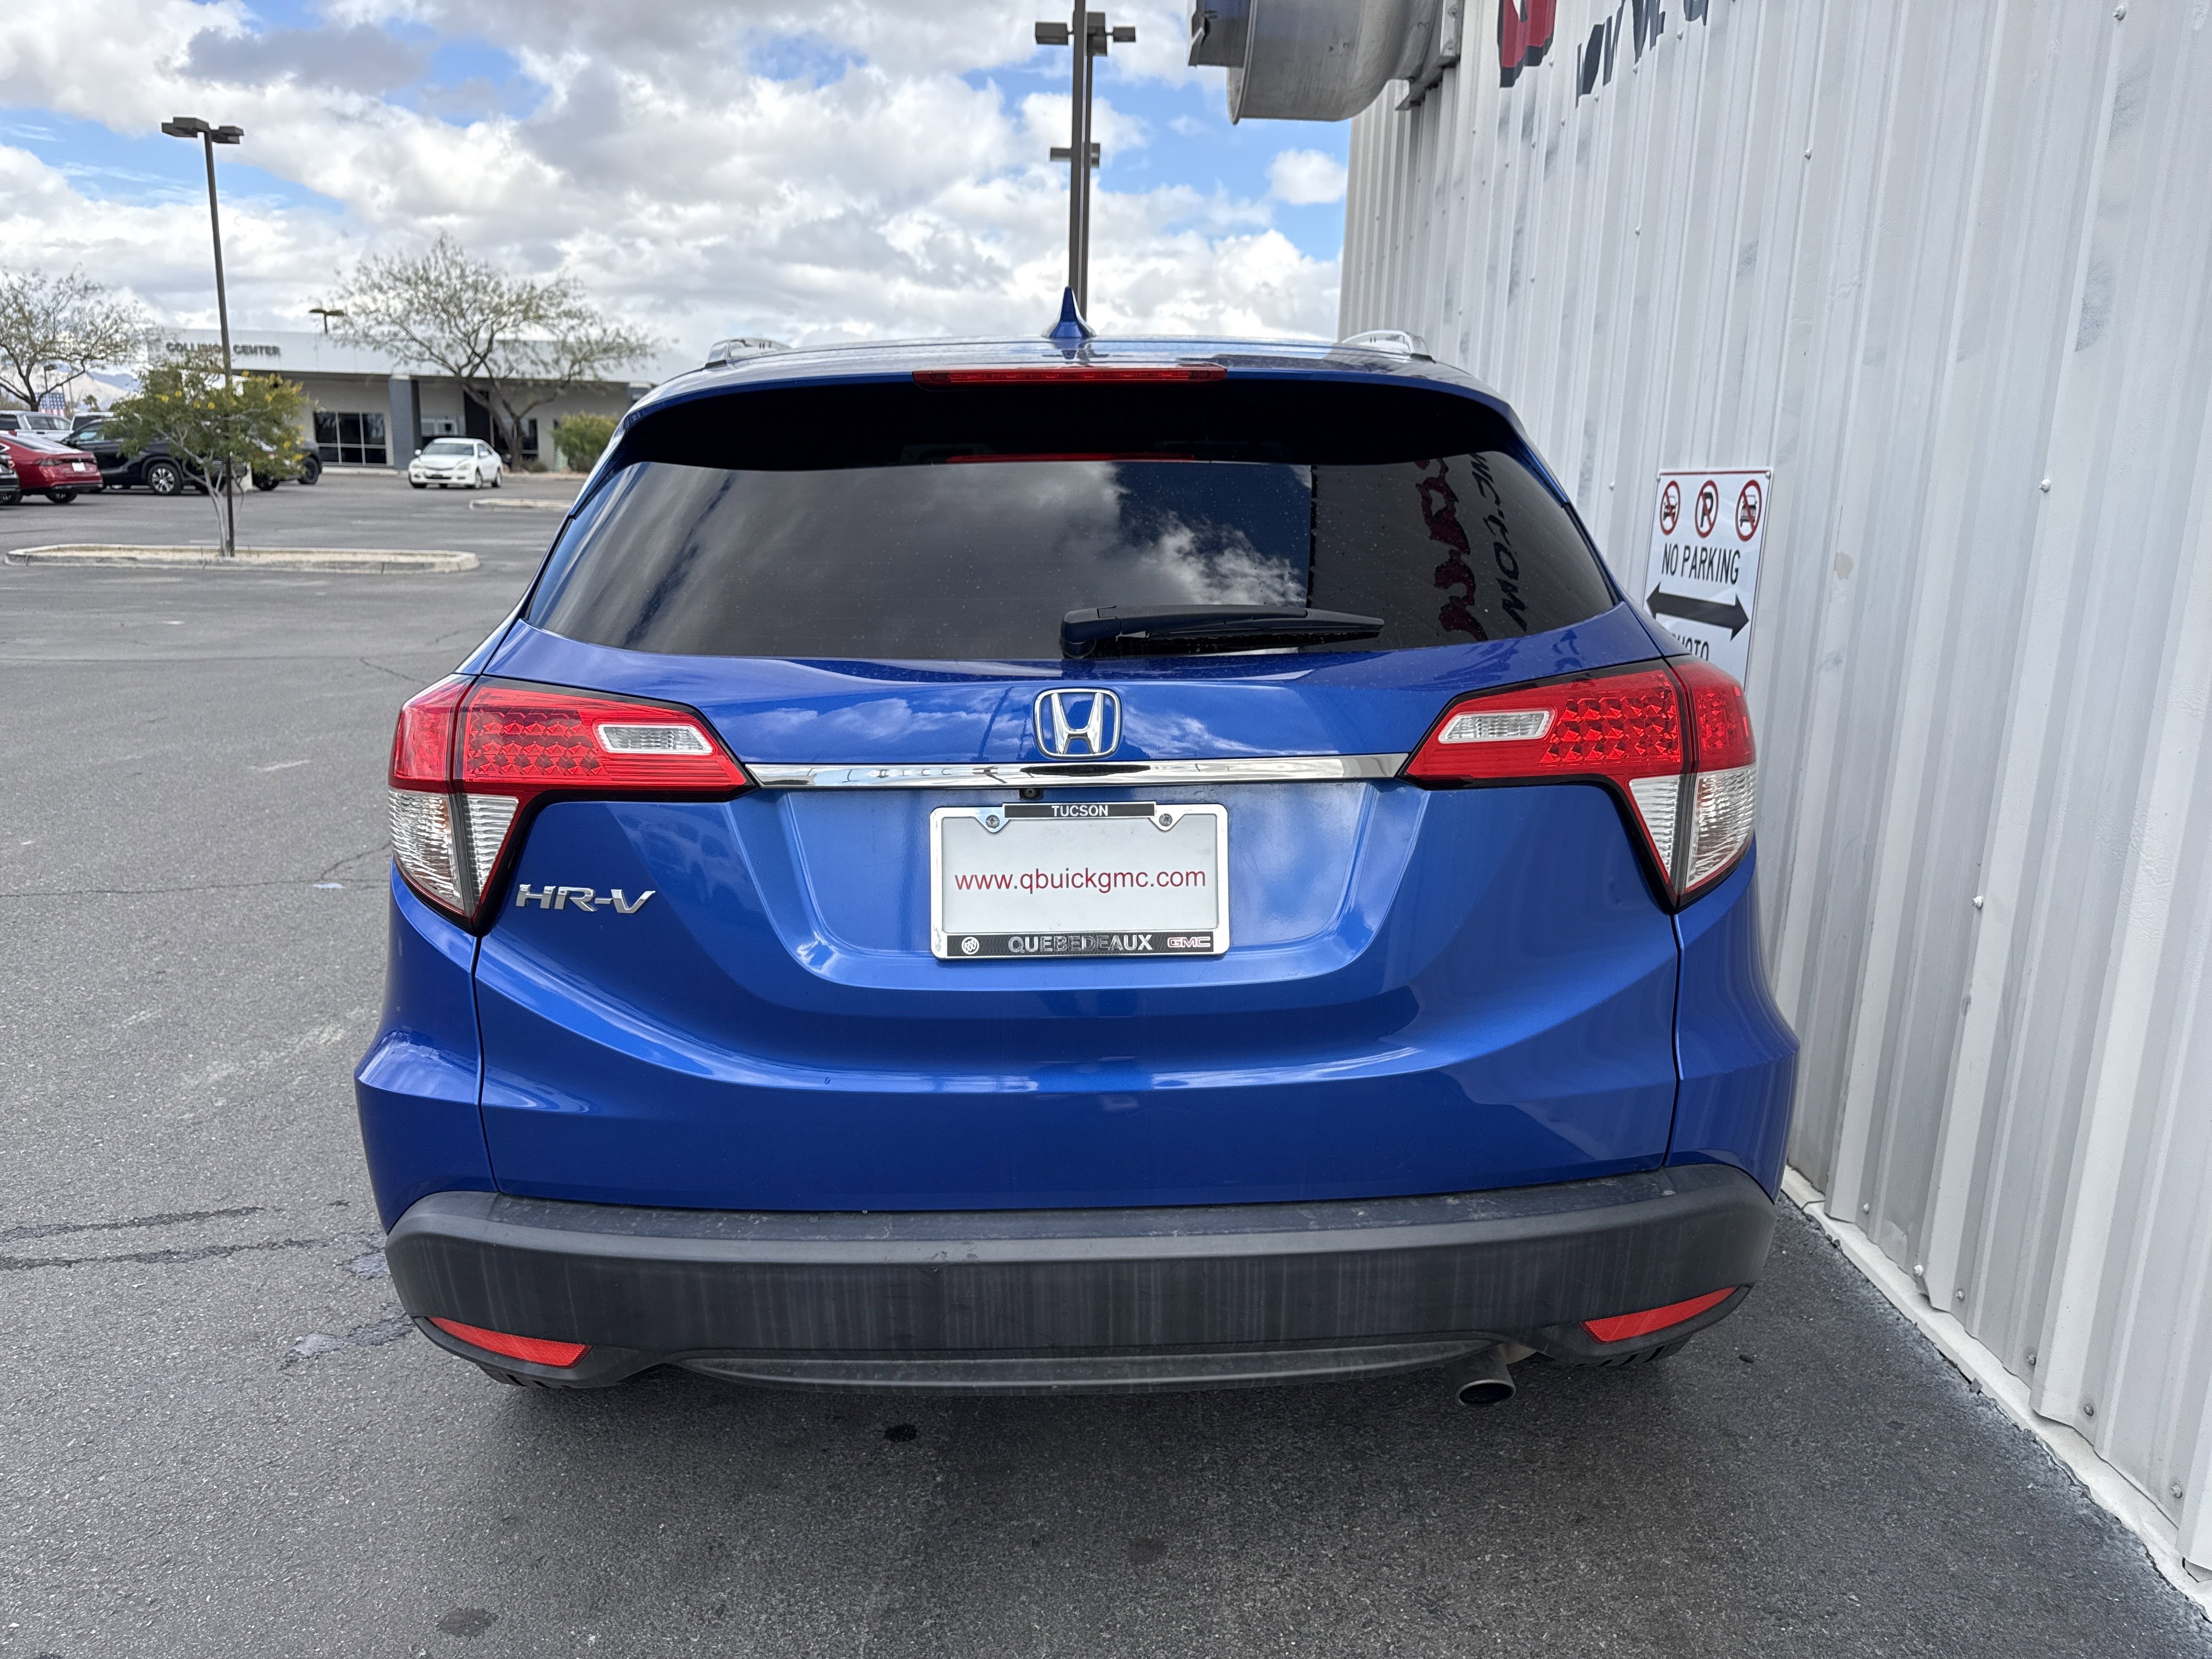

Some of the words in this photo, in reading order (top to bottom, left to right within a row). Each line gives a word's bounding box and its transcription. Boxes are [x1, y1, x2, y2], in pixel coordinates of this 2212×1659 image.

[166, 342, 222, 354] COLLISIO
[233, 345, 281, 357] CENTER
[1661, 543, 1679, 576] NO
[1680, 545, 1741, 585] PARKING
[1052, 804, 1109, 817] TUCSON
[954, 867, 1206, 894] www.qbuickgmc.com
[516, 884, 656, 914] HR-V
[1008, 934, 1153, 953] QUEBEDEAUX
[1166, 935, 1211, 948] GMC
